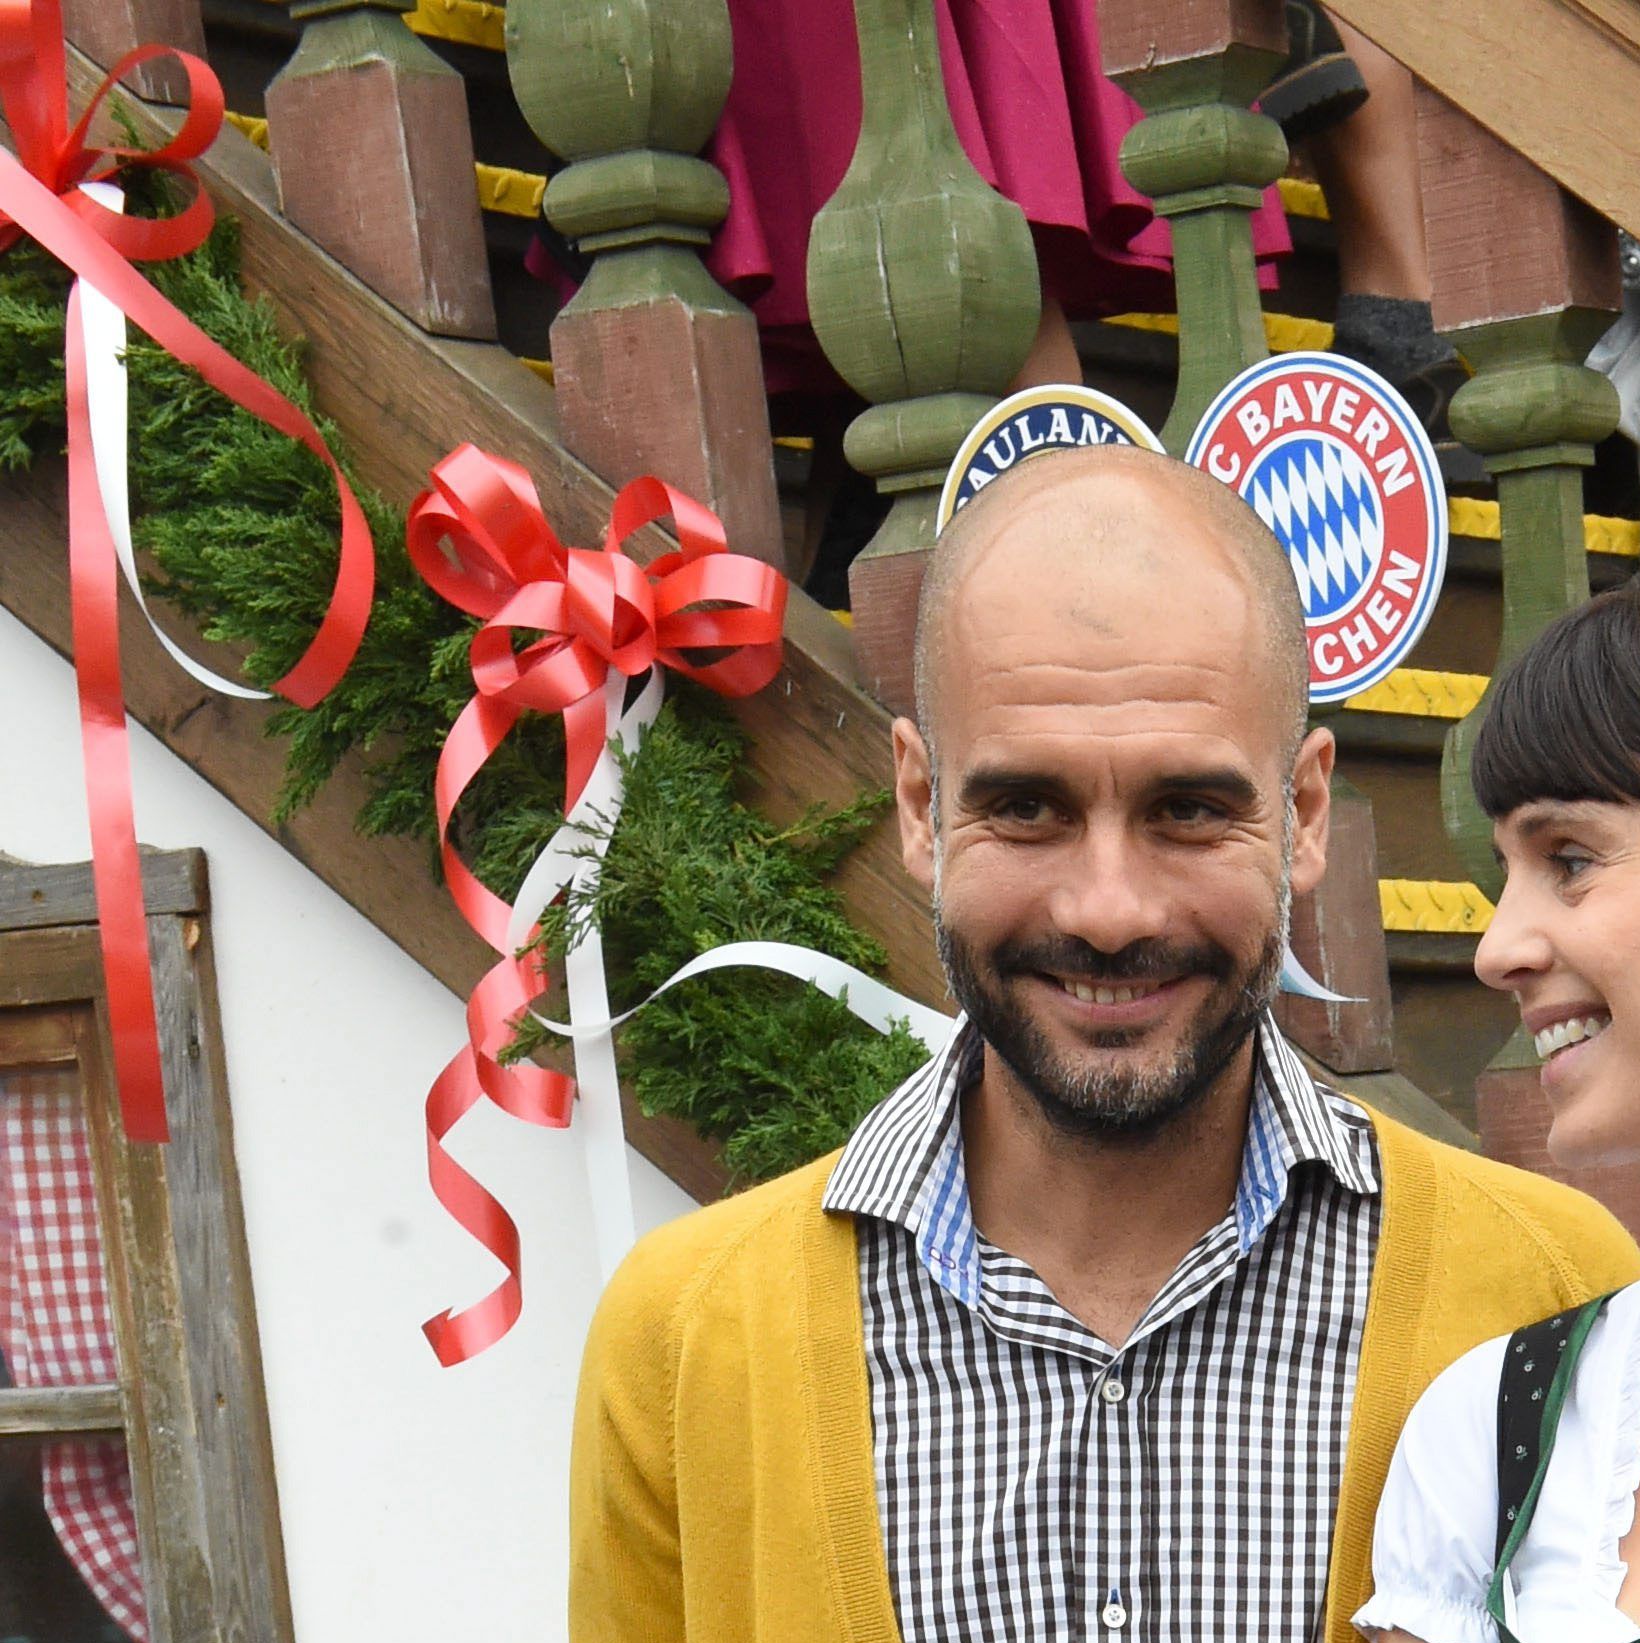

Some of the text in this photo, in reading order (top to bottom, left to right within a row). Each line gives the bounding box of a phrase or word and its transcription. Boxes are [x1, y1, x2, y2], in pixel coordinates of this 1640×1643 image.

[956, 407, 1132, 511] AULAN
[1207, 380, 1415, 498] C BAYERN
[1305, 549, 1421, 676] CHEN
